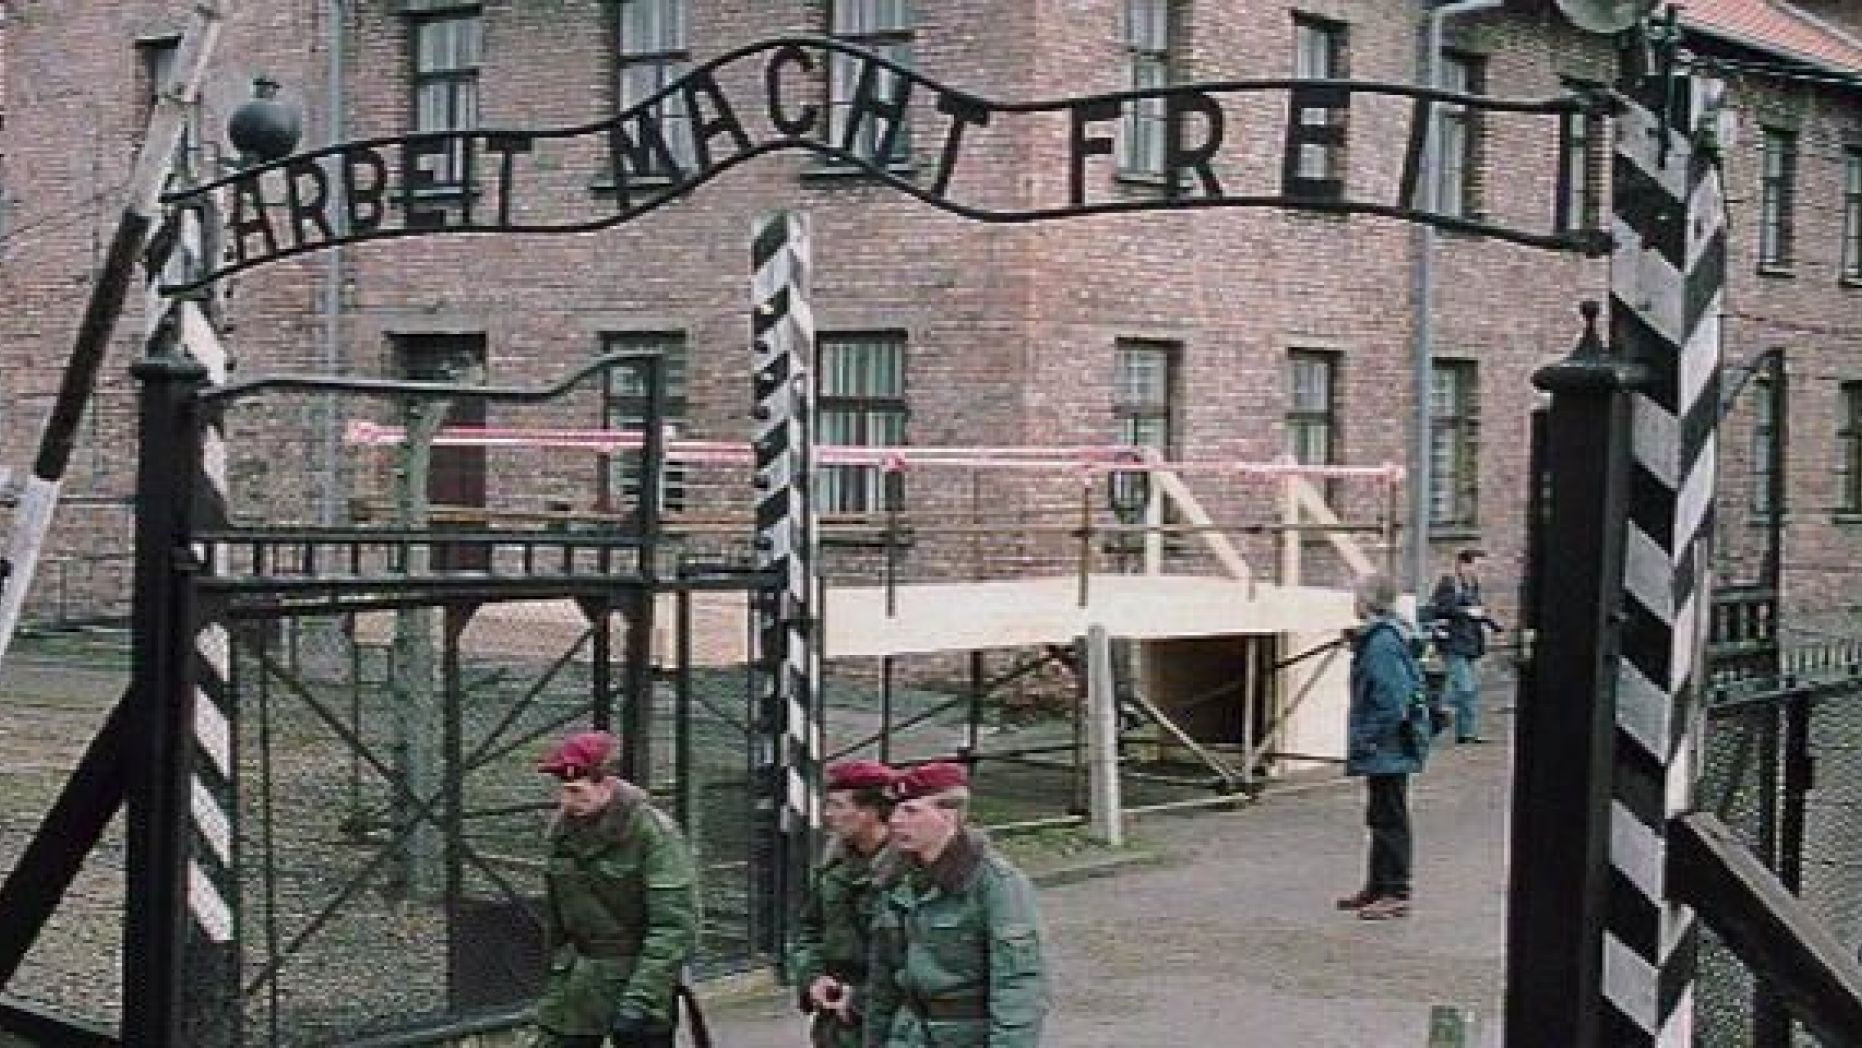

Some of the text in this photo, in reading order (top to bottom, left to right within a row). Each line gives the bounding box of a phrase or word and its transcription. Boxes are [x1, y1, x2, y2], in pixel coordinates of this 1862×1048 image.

[229, 46, 1423, 266] ARBEIT MACHT FREI
